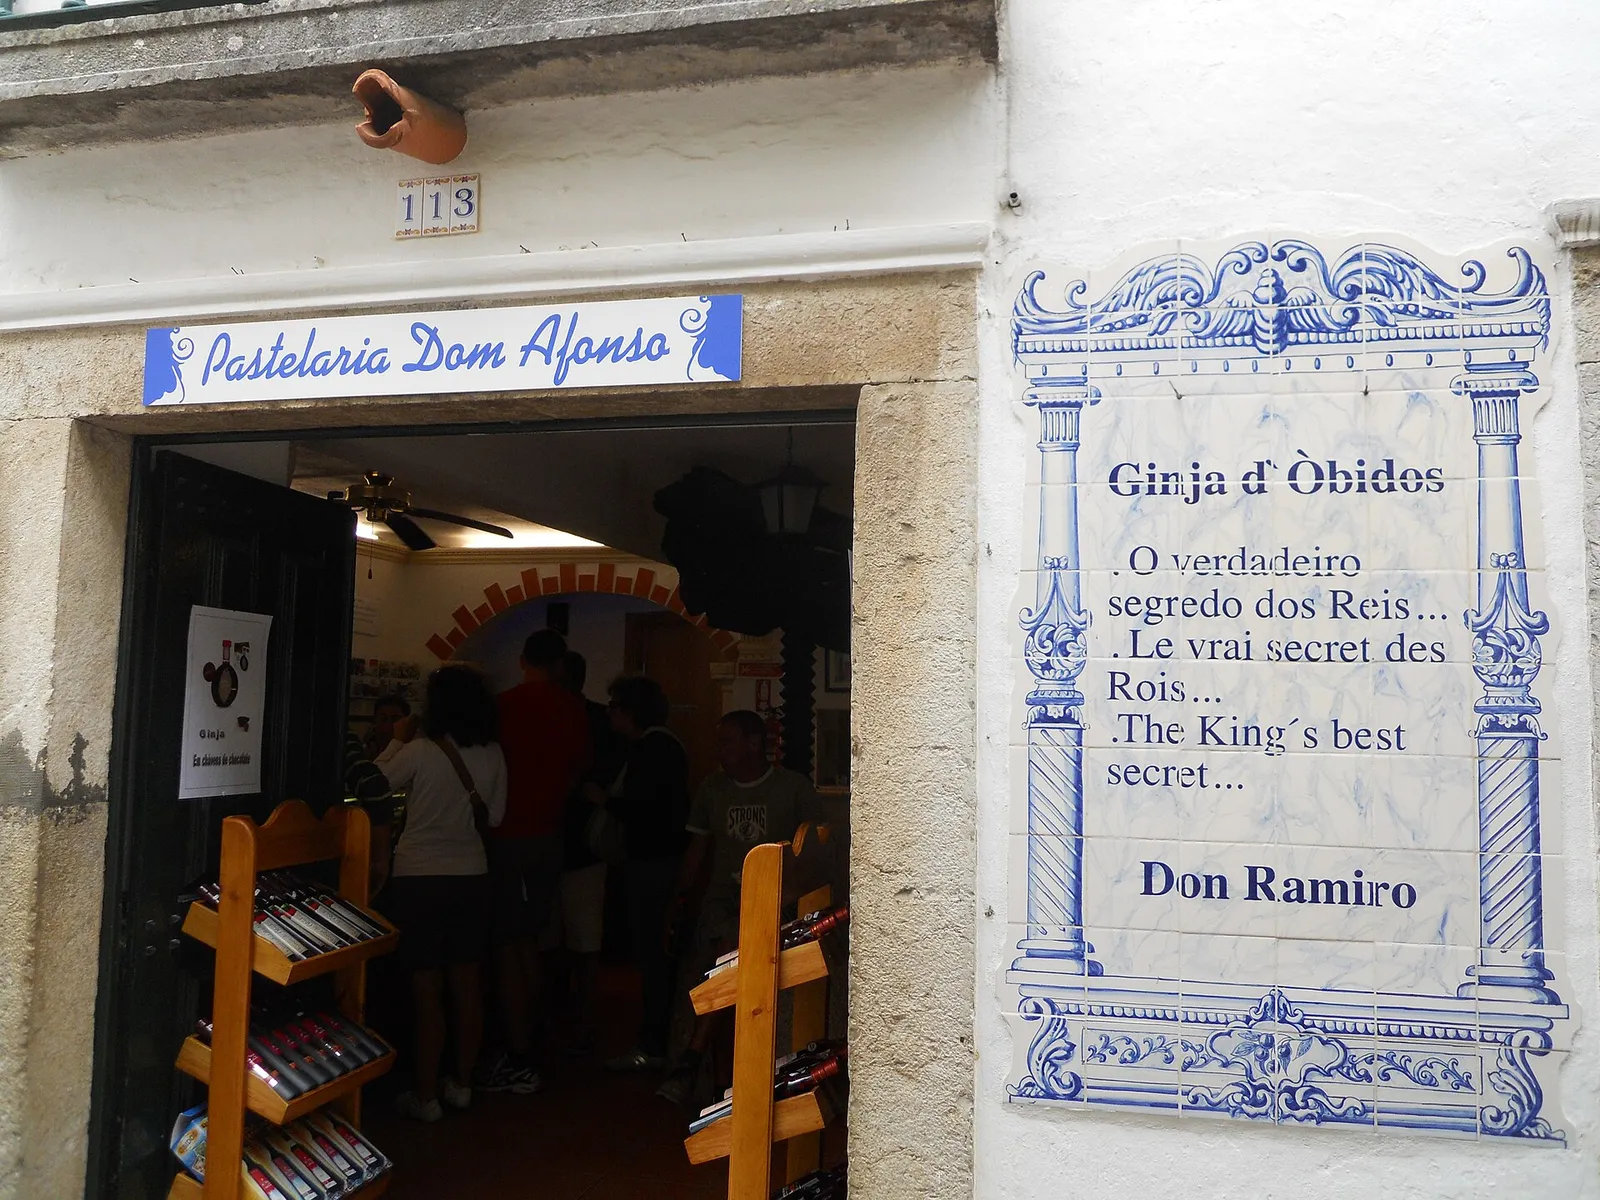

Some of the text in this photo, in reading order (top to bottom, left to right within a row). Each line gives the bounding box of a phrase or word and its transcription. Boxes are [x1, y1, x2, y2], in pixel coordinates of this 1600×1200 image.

[402, 188, 475, 222] 113
[201, 311, 671, 387] Pastelaria Dom Afonso
[1108, 461, 1228, 505] Ginja
[1287, 448, 1446, 495] Òbidos
[1170, 545, 1362, 577] verdadeiro
[1108, 588, 1243, 625] segredo
[1255, 588, 1316, 619] dos
[1186, 630, 1254, 661] vrai
[1266, 636, 1371, 663] secret
[1385, 633, 1446, 663] des
[199, 729, 225, 741] Ginja
[1331, 719, 1407, 751] best
[729, 807, 766, 831] STRONG
[1139, 860, 1417, 909] Don Ramiro
